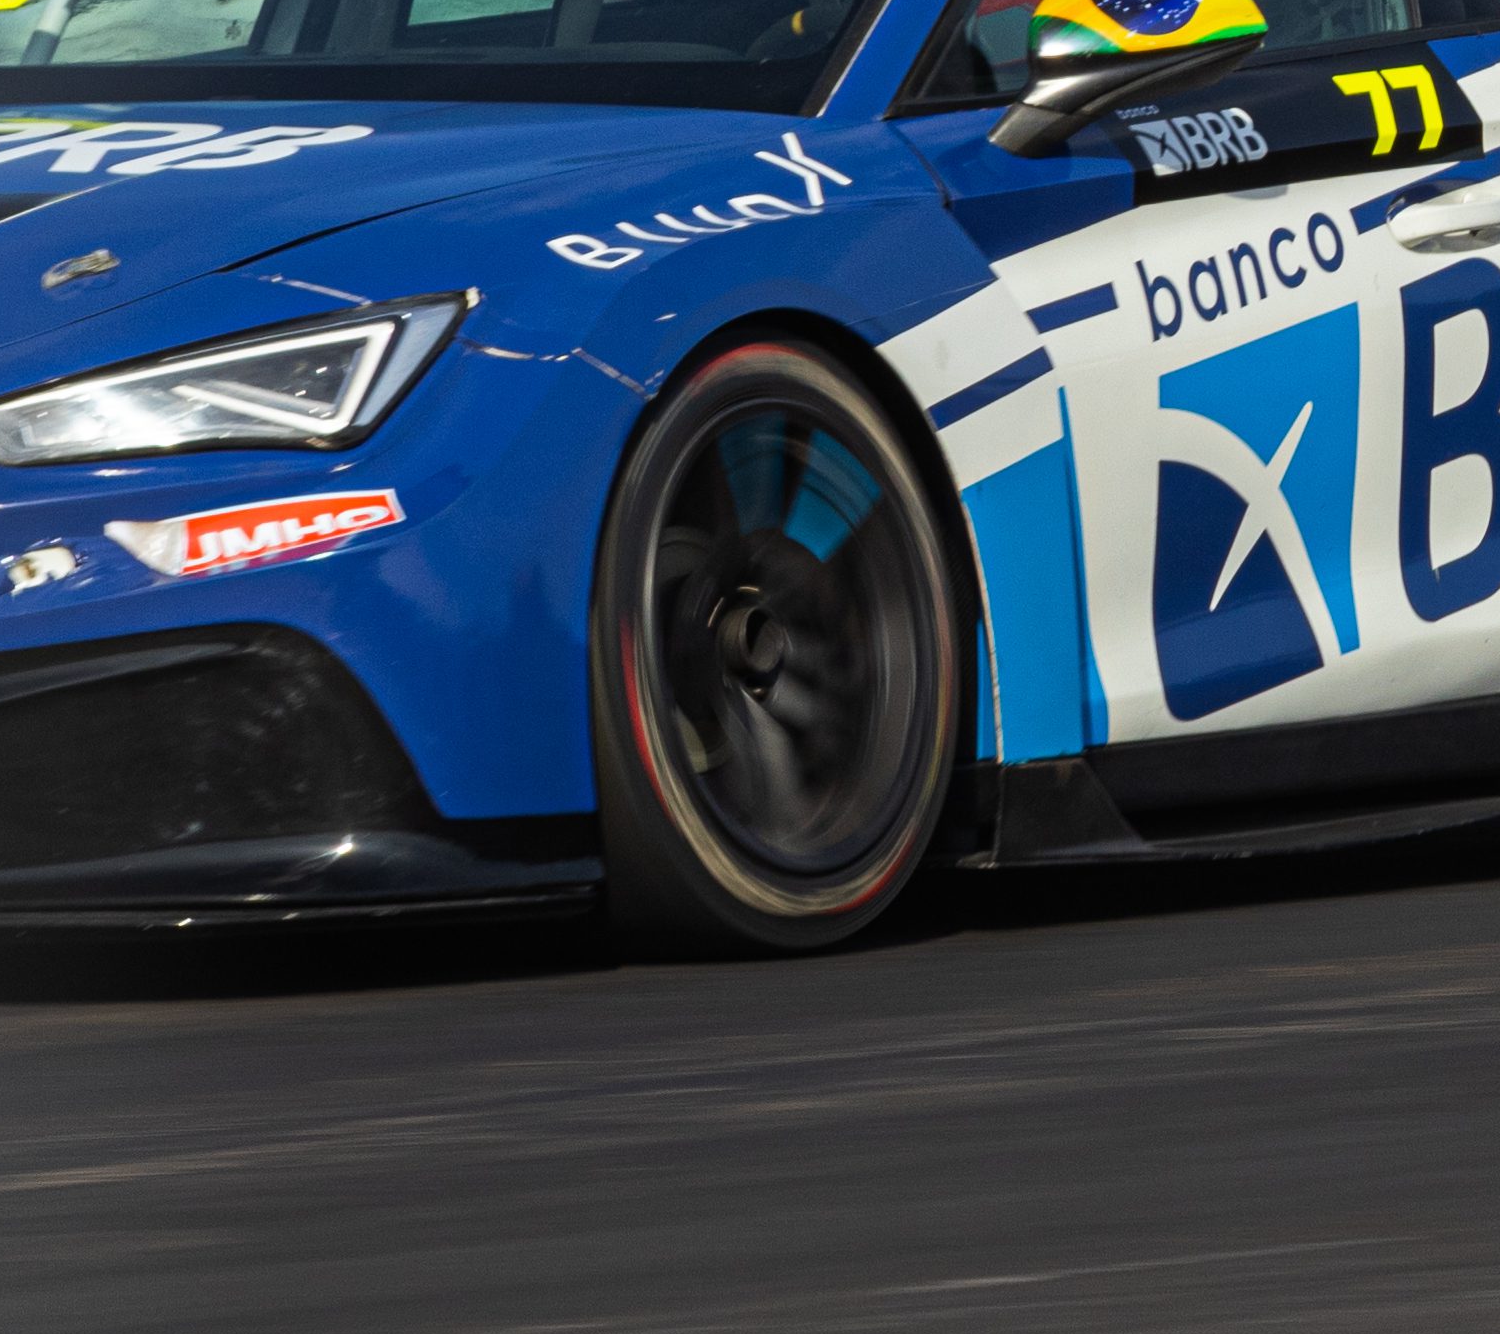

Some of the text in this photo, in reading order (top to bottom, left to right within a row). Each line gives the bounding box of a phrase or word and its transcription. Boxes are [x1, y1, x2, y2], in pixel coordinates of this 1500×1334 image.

[1171, 107, 1269, 170] BRB
[1331, 64, 1444, 156] 77
[1135, 211, 1344, 342] banco
